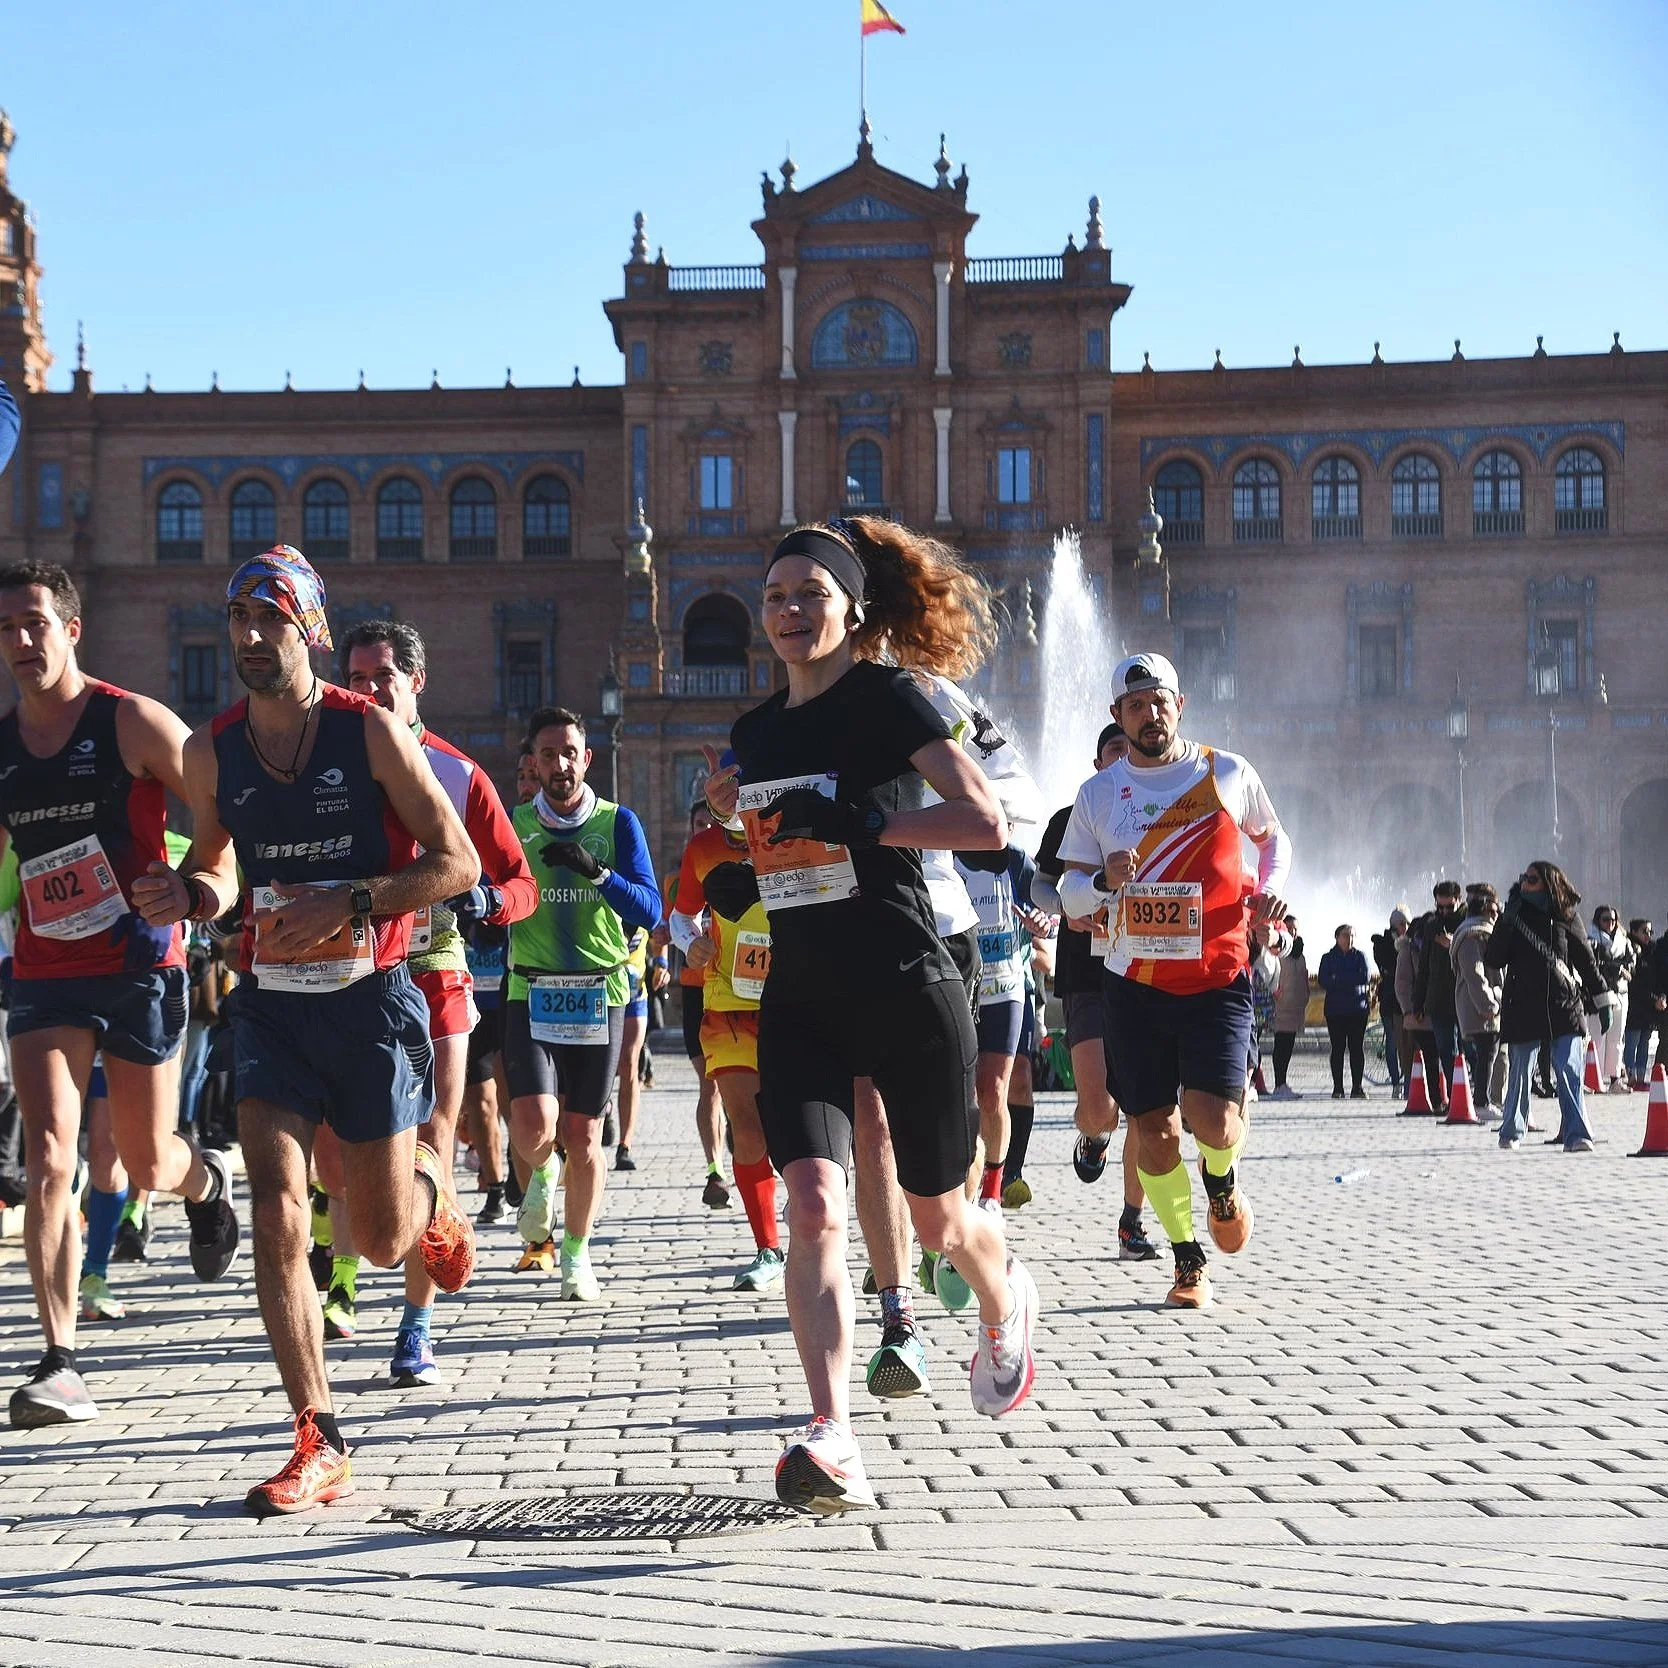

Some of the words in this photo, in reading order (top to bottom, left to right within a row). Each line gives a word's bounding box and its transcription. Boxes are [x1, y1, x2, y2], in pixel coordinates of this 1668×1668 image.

[327, 803, 350, 813] BOLA
[746, 791, 762, 804] edp
[8, 802, 95, 827] Vanessa
[254, 834, 353, 859] Vanessa
[786, 869, 804, 882] edp
[43, 870, 84, 904] 402
[1132, 901, 1181, 925] 3932
[977, 938, 1000, 955] 84
[541, 992, 590, 1013] 3264
